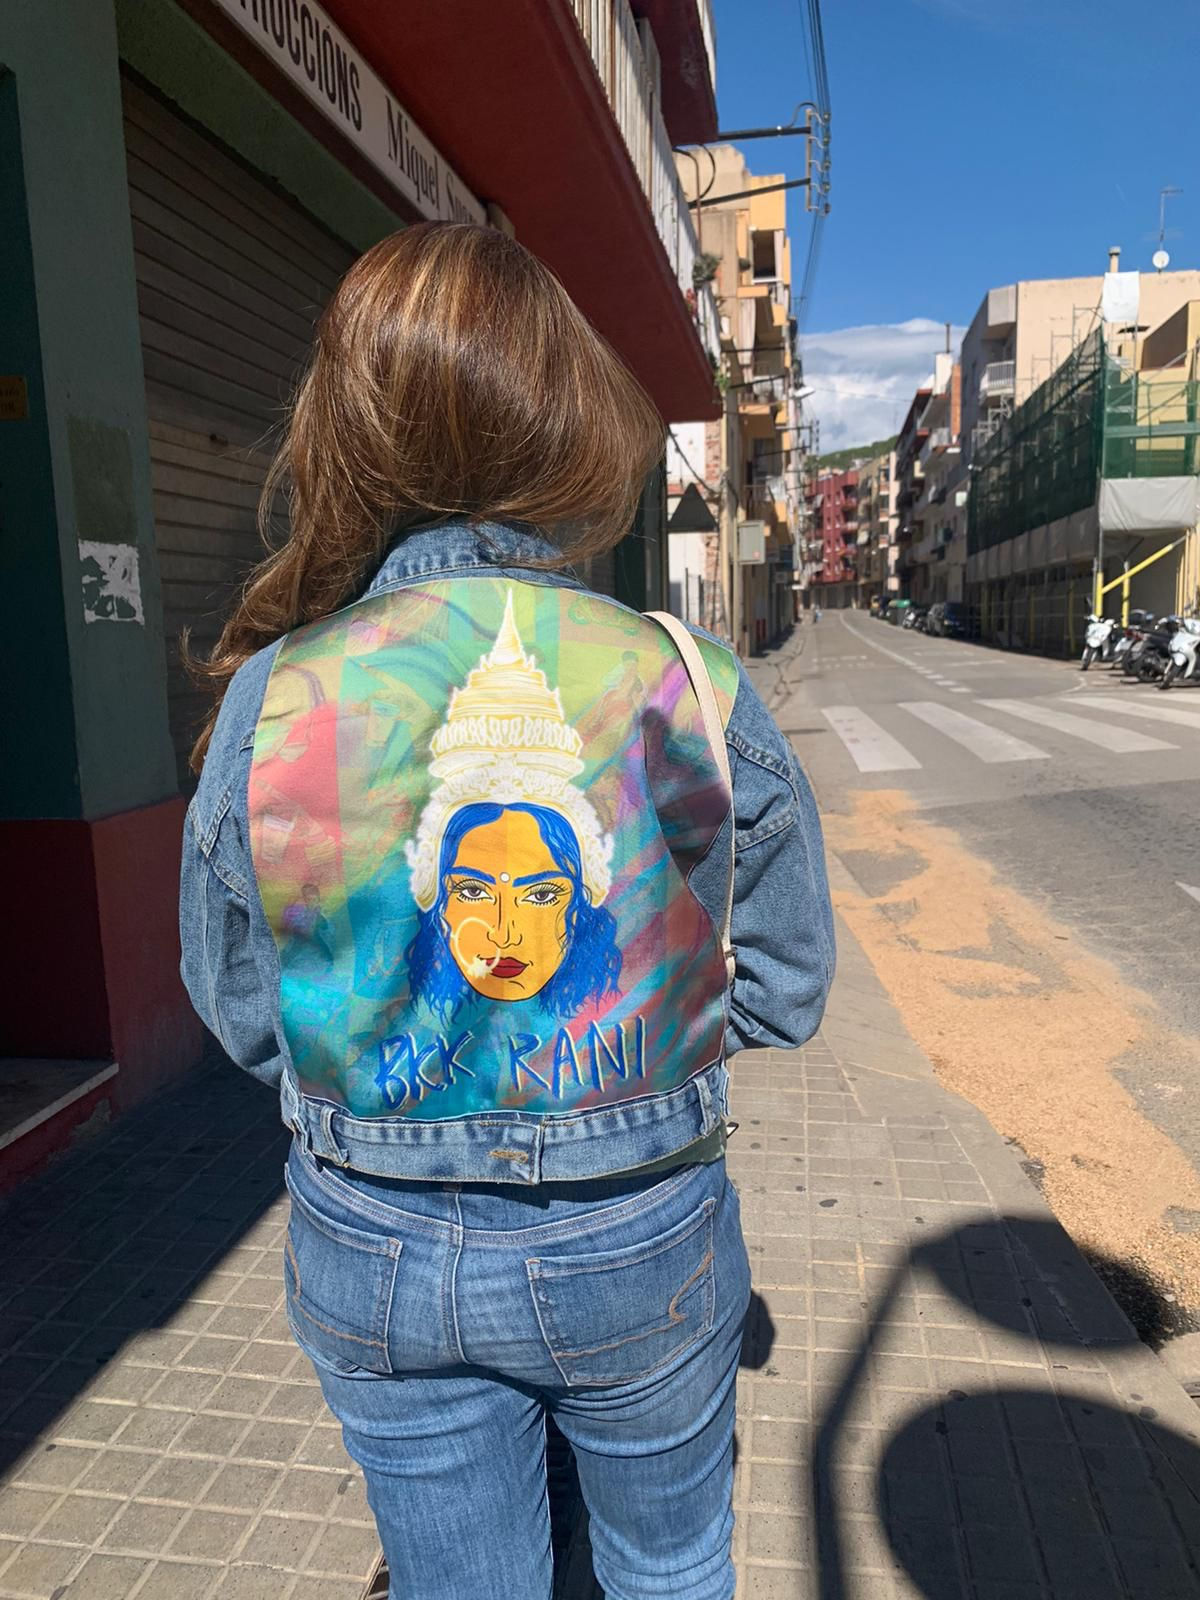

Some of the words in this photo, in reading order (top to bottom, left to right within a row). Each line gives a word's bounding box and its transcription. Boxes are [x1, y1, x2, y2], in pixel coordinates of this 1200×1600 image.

[238, 0, 363, 132] UCCIONS
[384, 94, 441, 211] Miquel
[374, 1030, 476, 1111] BKK
[508, 1014, 648, 1101] RANI
